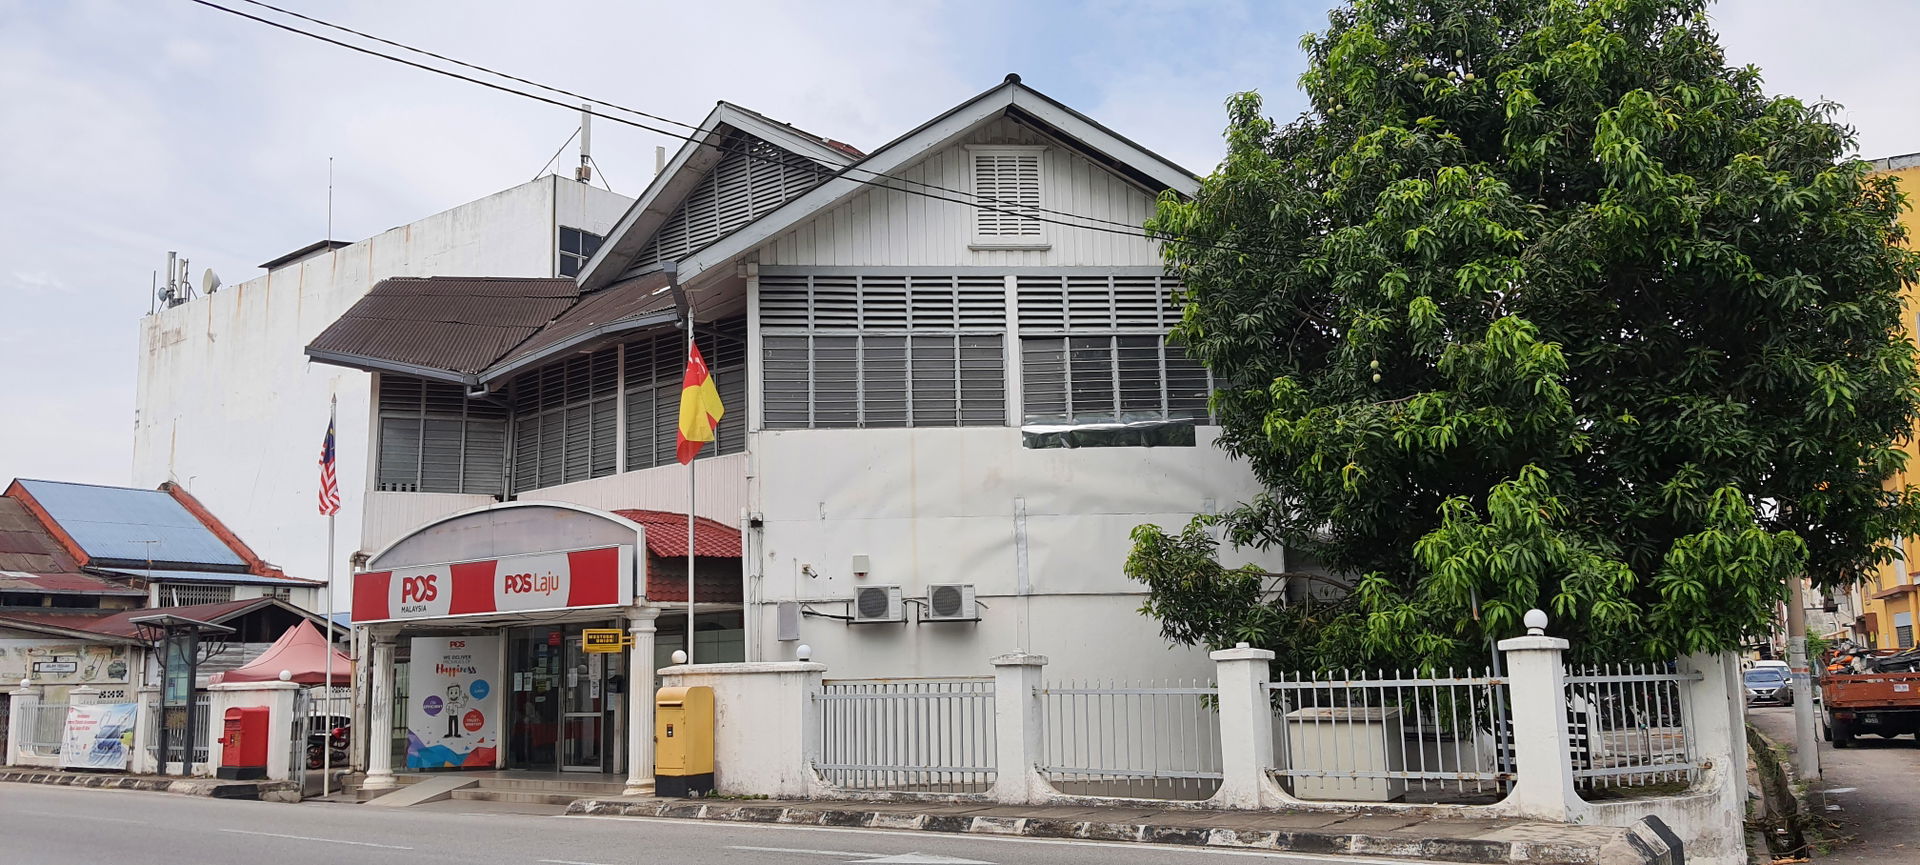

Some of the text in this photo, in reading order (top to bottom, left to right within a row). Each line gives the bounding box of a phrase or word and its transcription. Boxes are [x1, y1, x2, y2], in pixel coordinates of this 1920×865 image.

[402, 575, 438, 603] POS
[505, 571, 559, 596] POS Laju
[401, 605, 427, 613] MALAYSIA
